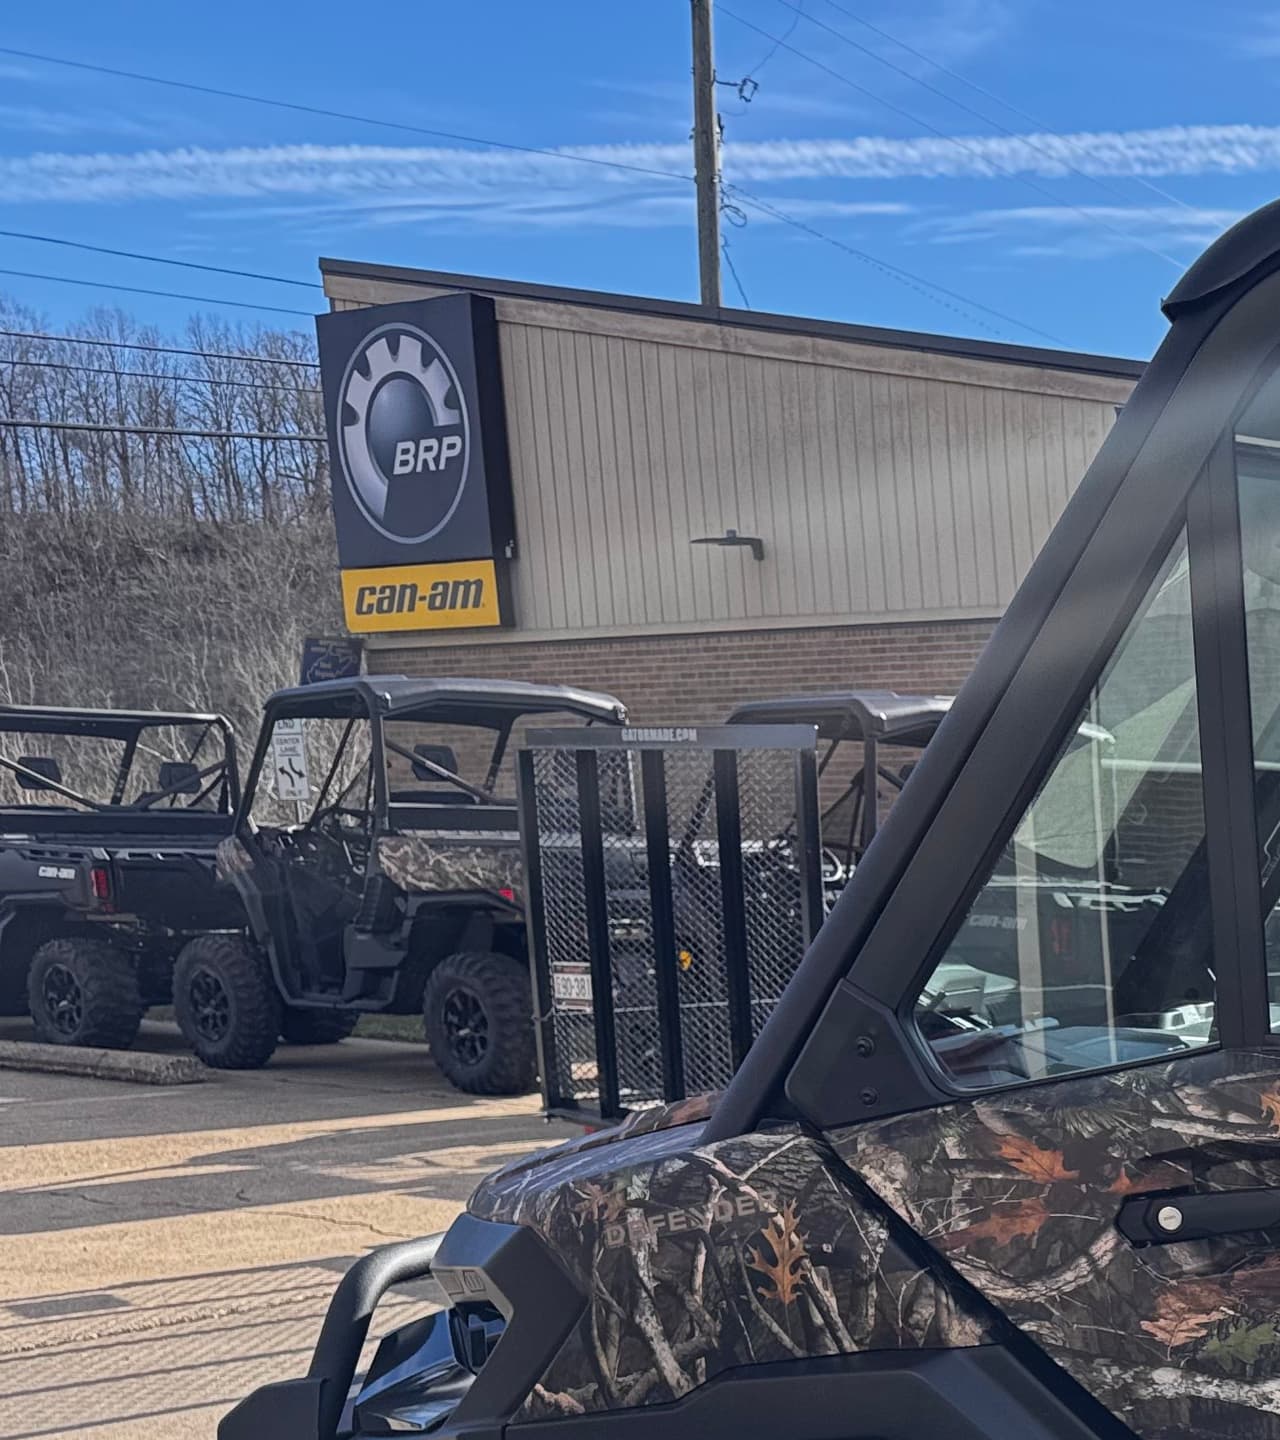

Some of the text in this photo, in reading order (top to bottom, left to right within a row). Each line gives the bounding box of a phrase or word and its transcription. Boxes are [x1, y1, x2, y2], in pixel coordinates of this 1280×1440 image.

[393, 435, 463, 476] BRP
[355, 578, 484, 616] can-am
[605, 1191, 778, 1249] DEFENDER
